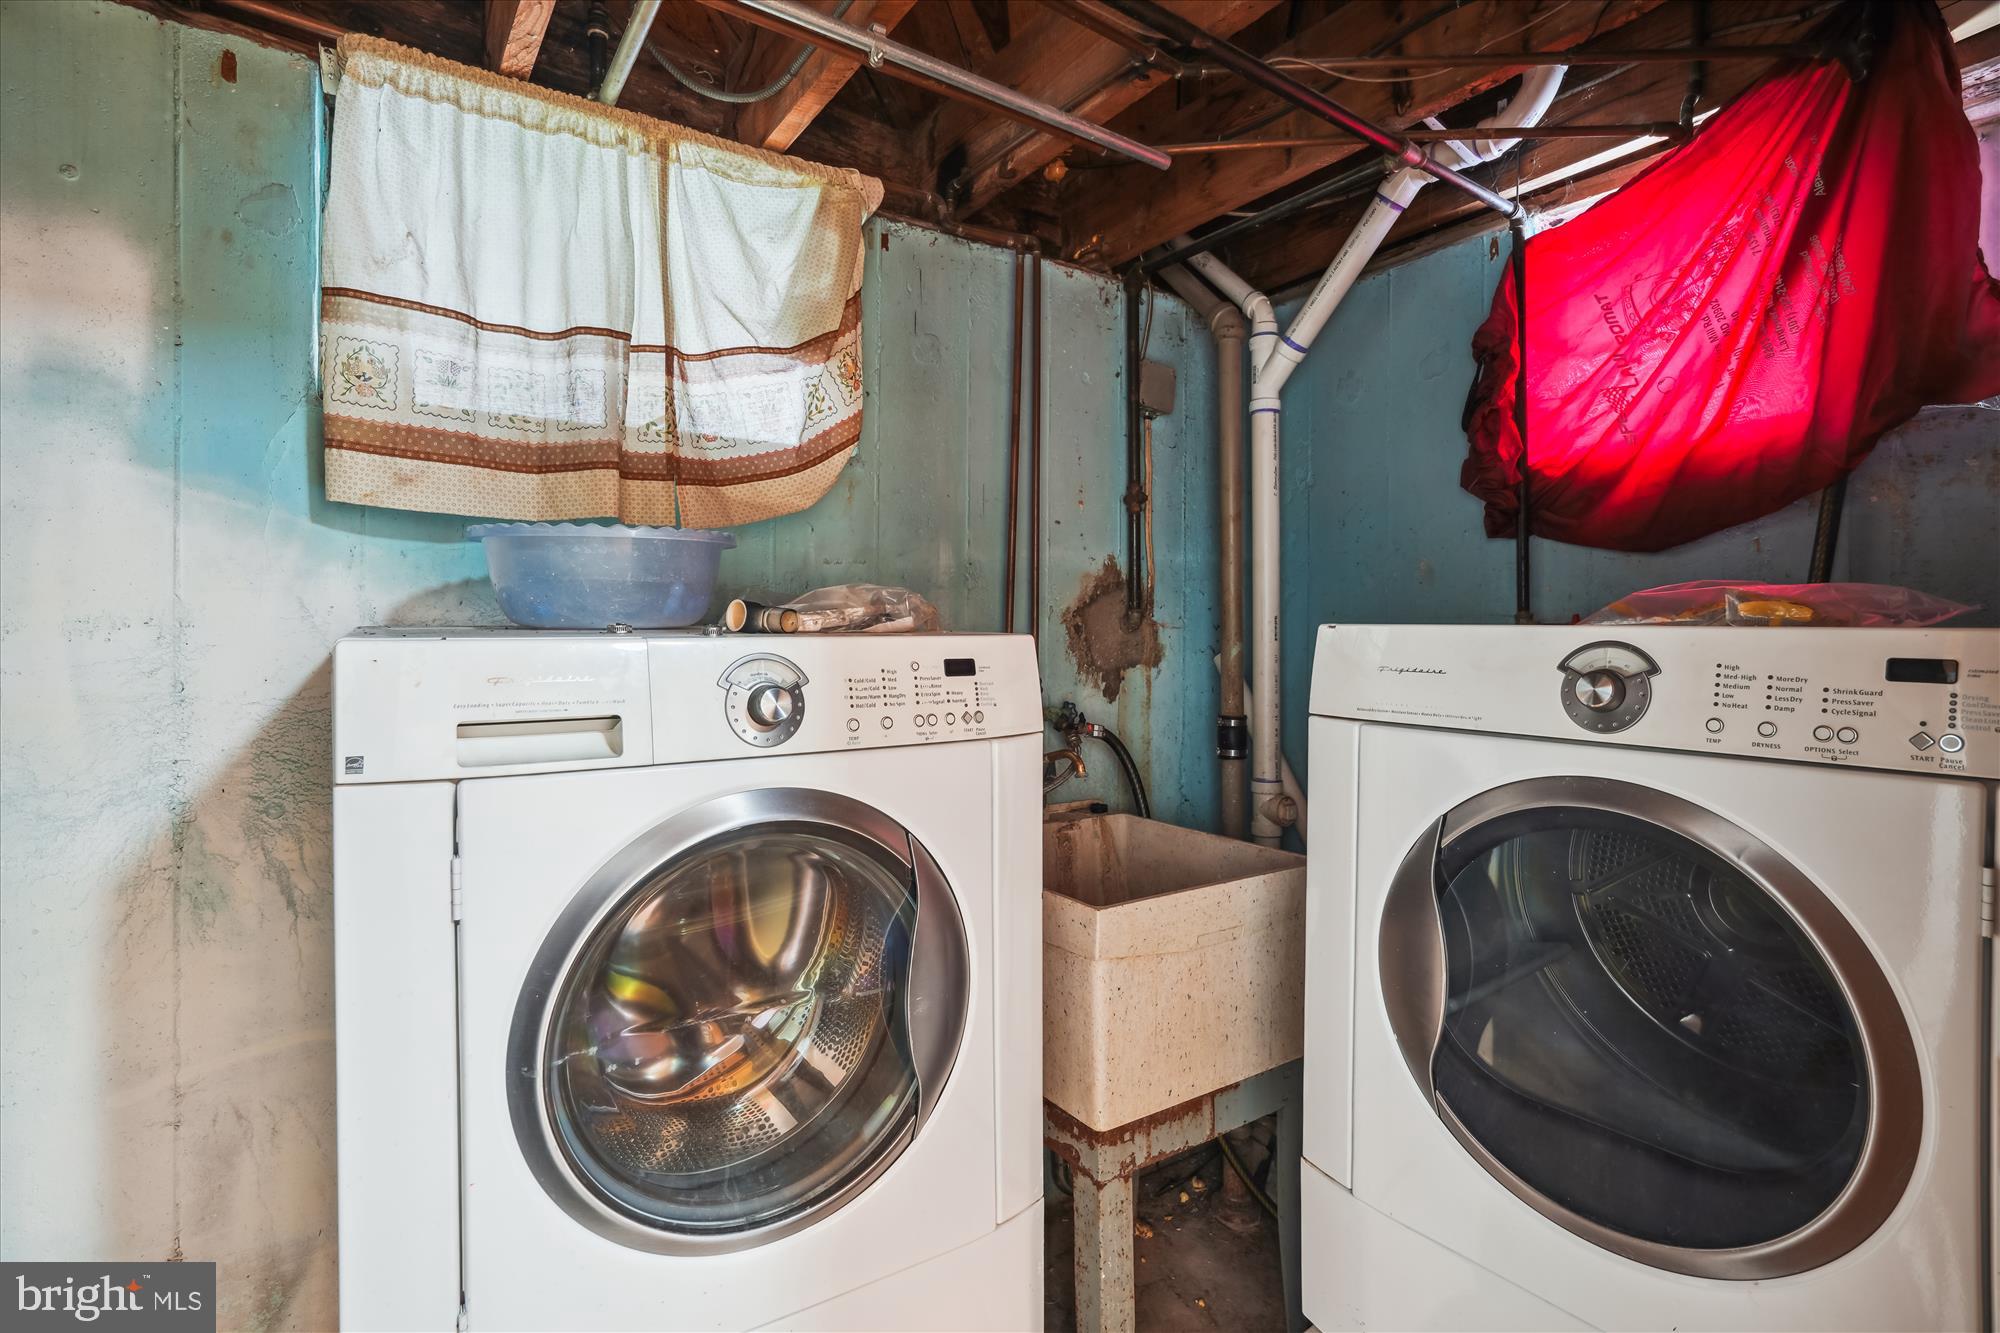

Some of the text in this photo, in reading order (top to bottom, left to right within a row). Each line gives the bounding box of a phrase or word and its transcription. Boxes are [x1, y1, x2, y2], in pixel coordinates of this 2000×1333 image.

[1376, 664, 1446, 675] Frigidaire
[1774, 705, 1796, 713] Damp
[1752, 741, 1782, 749] DRYNESS
[1804, 746, 1860, 756] OPTIONS Select
[1910, 754, 1935, 762] START
